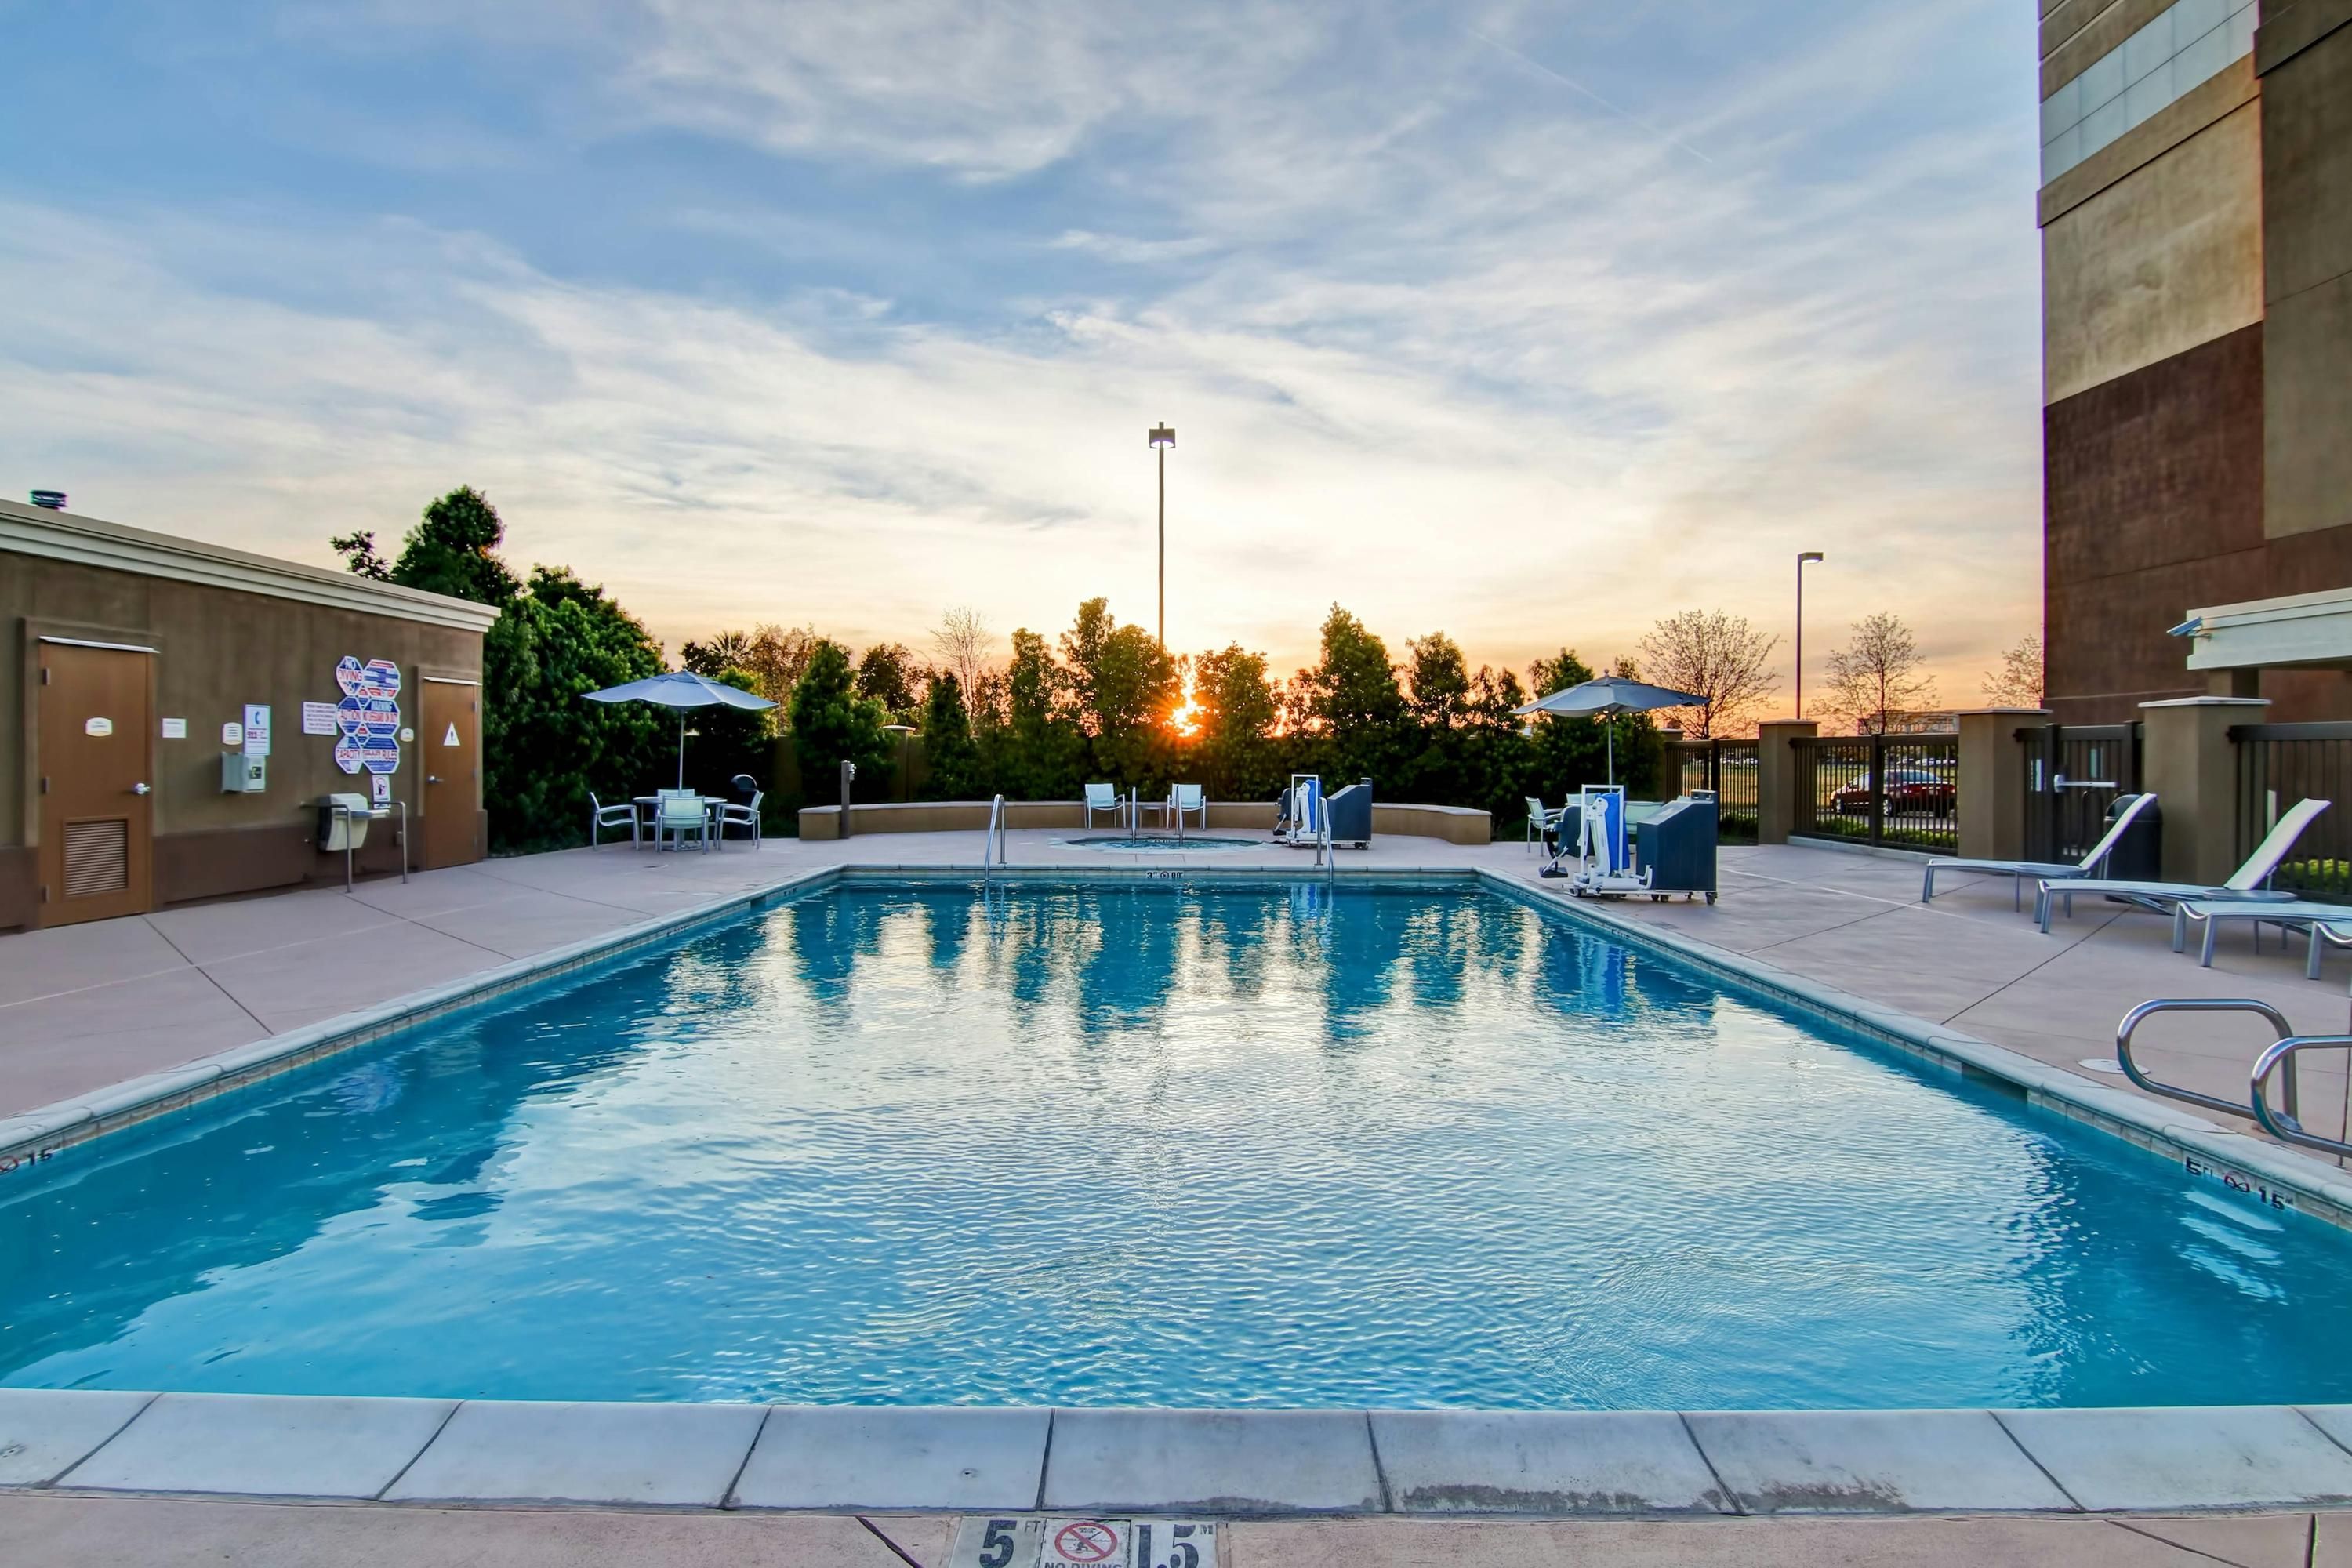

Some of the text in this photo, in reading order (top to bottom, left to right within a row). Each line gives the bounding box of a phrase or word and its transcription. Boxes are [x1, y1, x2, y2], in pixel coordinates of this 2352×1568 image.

[345, 658, 356, 670] NO
[338, 669, 362, 681] DIVING
[336, 749, 361, 760] CAPACITY
[1200, 1524, 1214, 1535] M
[979, 1519, 1041, 1568] 5 FT
